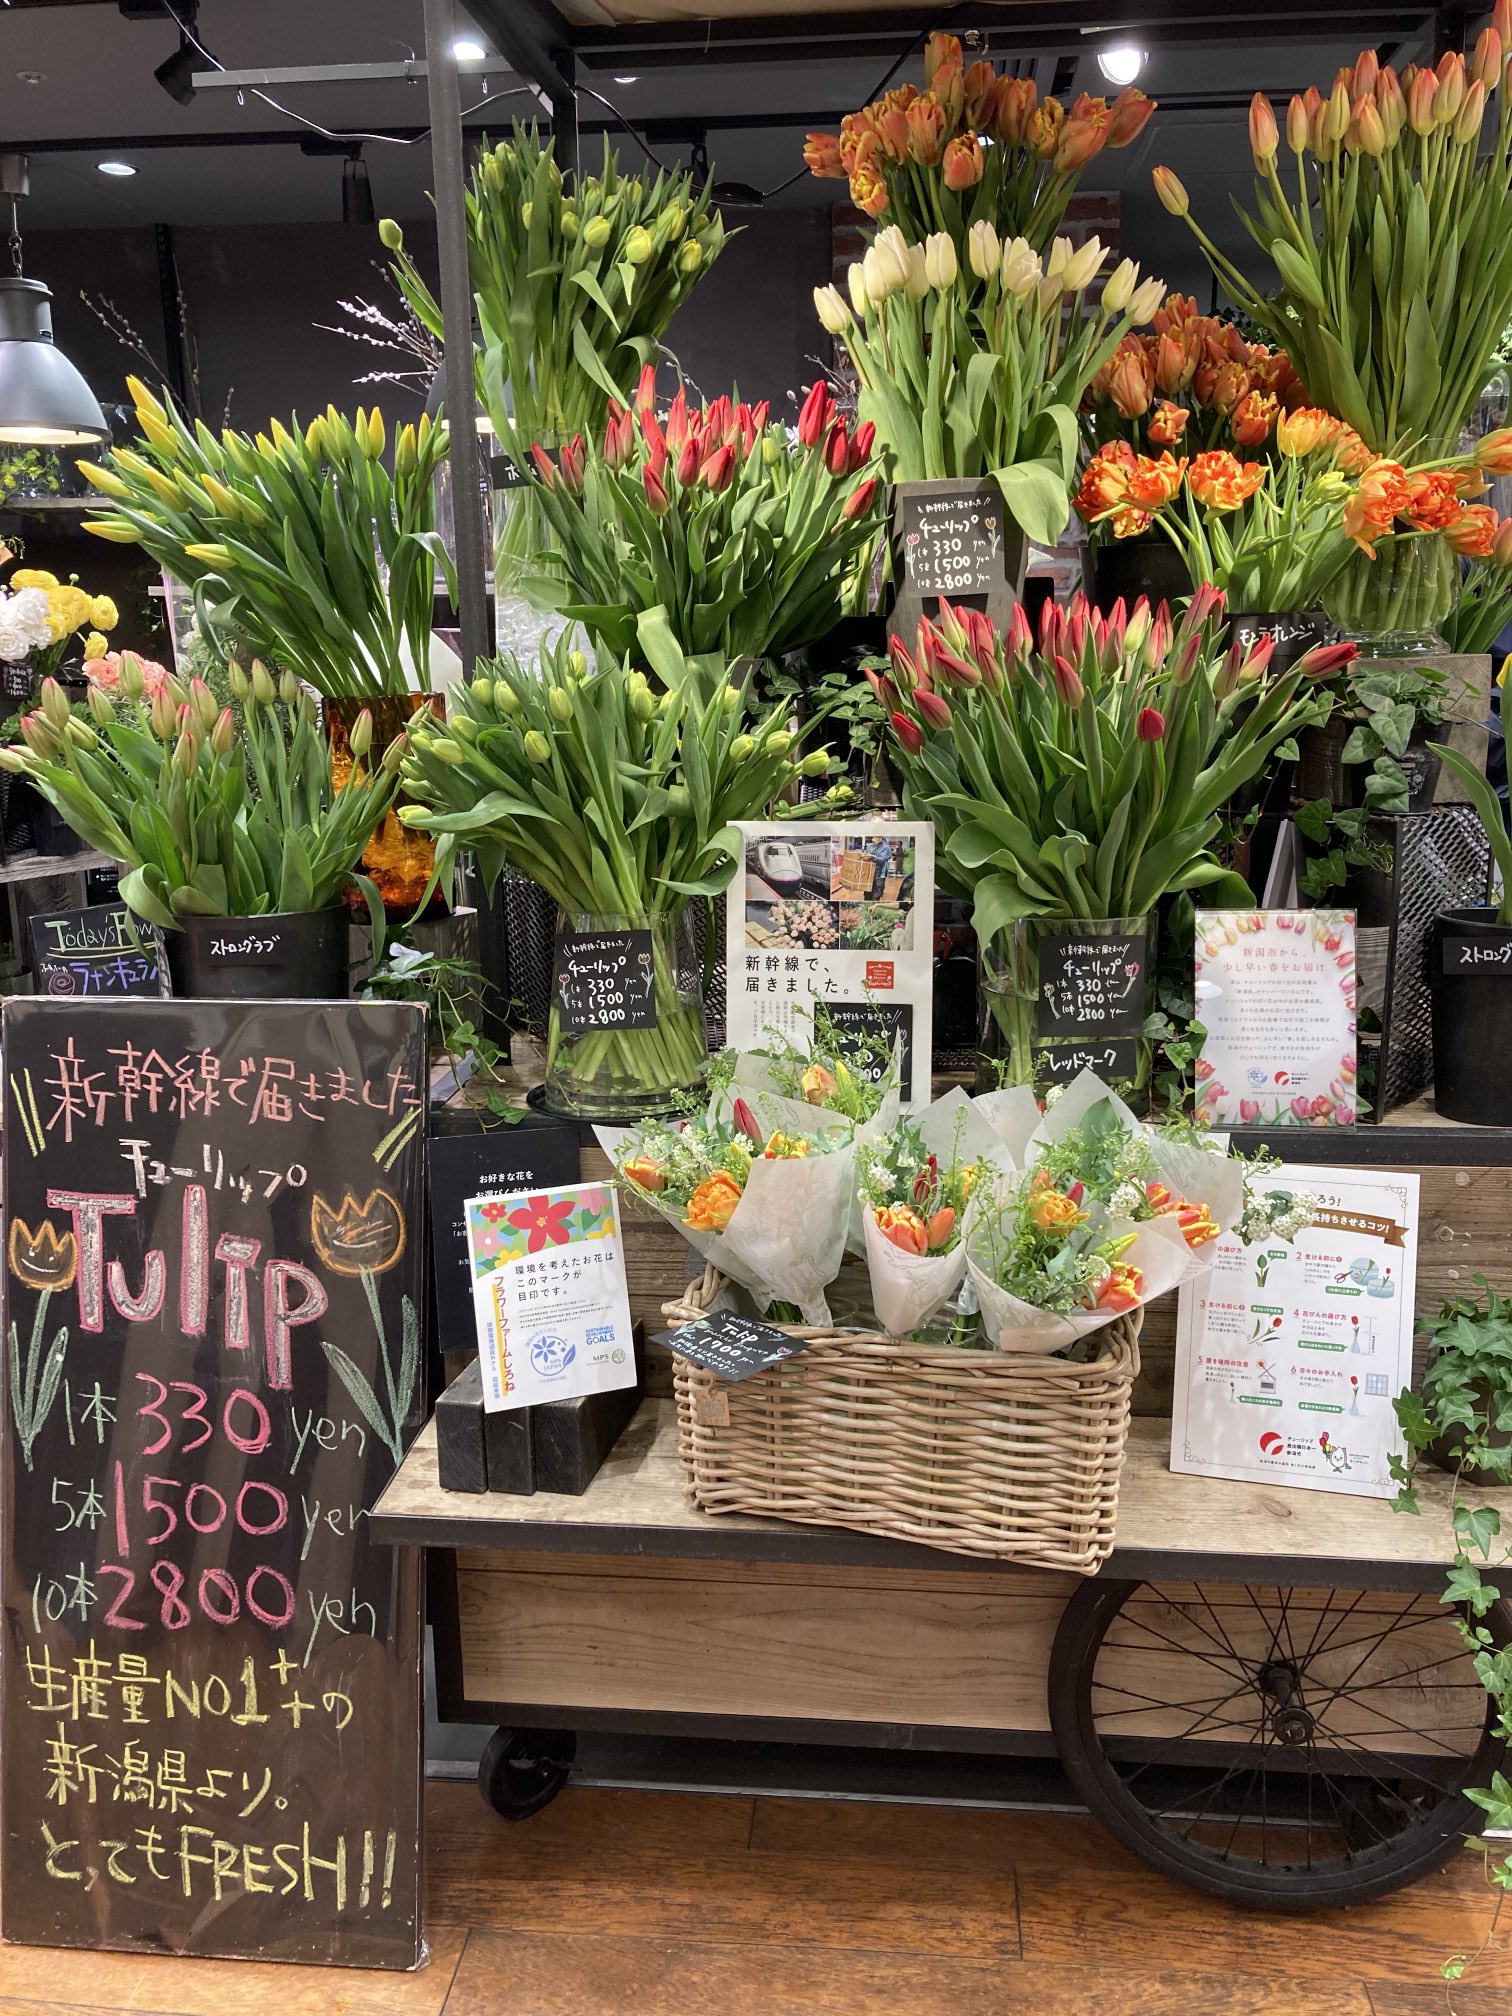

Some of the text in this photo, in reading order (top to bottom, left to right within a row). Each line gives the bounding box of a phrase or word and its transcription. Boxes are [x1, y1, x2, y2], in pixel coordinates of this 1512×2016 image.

[919, 514, 979, 540] チューリップ
[932, 538, 962, 557] 330
[973, 540, 986, 552] yen
[934, 556, 971, 574] 1500
[975, 555, 990, 569] yen
[934, 573, 972, 590] 2800
[976, 573, 991, 588] yen
[210, 935, 281, 956] ストロングラブ
[568, 955, 627, 978] チューリップ
[745, 955, 830, 973] 新幹線で、
[1062, 958, 1122, 977] チューリップ
[1223, 962, 1325, 973] 少し早い春をお届け
[587, 978, 615, 996] 330
[624, 977, 637, 991] yen
[745, 976, 849, 995] 届きました。
[1056, 978, 1069, 988] 1本
[1075, 979, 1102, 992] 330
[588, 991, 624, 1009] 1500
[630, 993, 643, 1005] yen
[1060, 991, 1074, 1001] 5本
[1077, 993, 1105, 1008] 1500
[588, 1009, 626, 1025] 2800
[631, 1011, 646, 1025] yen
[1062, 1004, 1075, 1016] 10本
[1076, 1008, 1105, 1022] 2800
[1049, 1049, 1117, 1072] レッドマーク
[44, 1036, 424, 1144] 新幹線で届きました
[118, 1137, 308, 1205] チューリップ
[478, 1169, 535, 1184] お好きな花を
[514, 1252, 615, 1275] 環境を考えたお花は
[517, 1269, 583, 1288] このマークが
[518, 1286, 569, 1302] 目印です。
[1199, 1299, 1206, 1308] 3
[1293, 1308, 1300, 1317] 4
[1302, 1310, 1347, 1321] 花びんの選び方
[494, 1276, 516, 1392] フラワーファームしろね
[586, 1333, 616, 1346] GOALS
[592, 1353, 610, 1361] MPS
[1290, 1365, 1297, 1375] 6
[1299, 1367, 1344, 1378] 日々のお手入れ
[64, 1372, 368, 1476] 1本 330 yen
[50, 1460, 371, 1561] 5本 1500 yen
[31, 1559, 377, 1669] 10本 2800 yen
[42, 1720, 290, 1818] 新潟県より。
